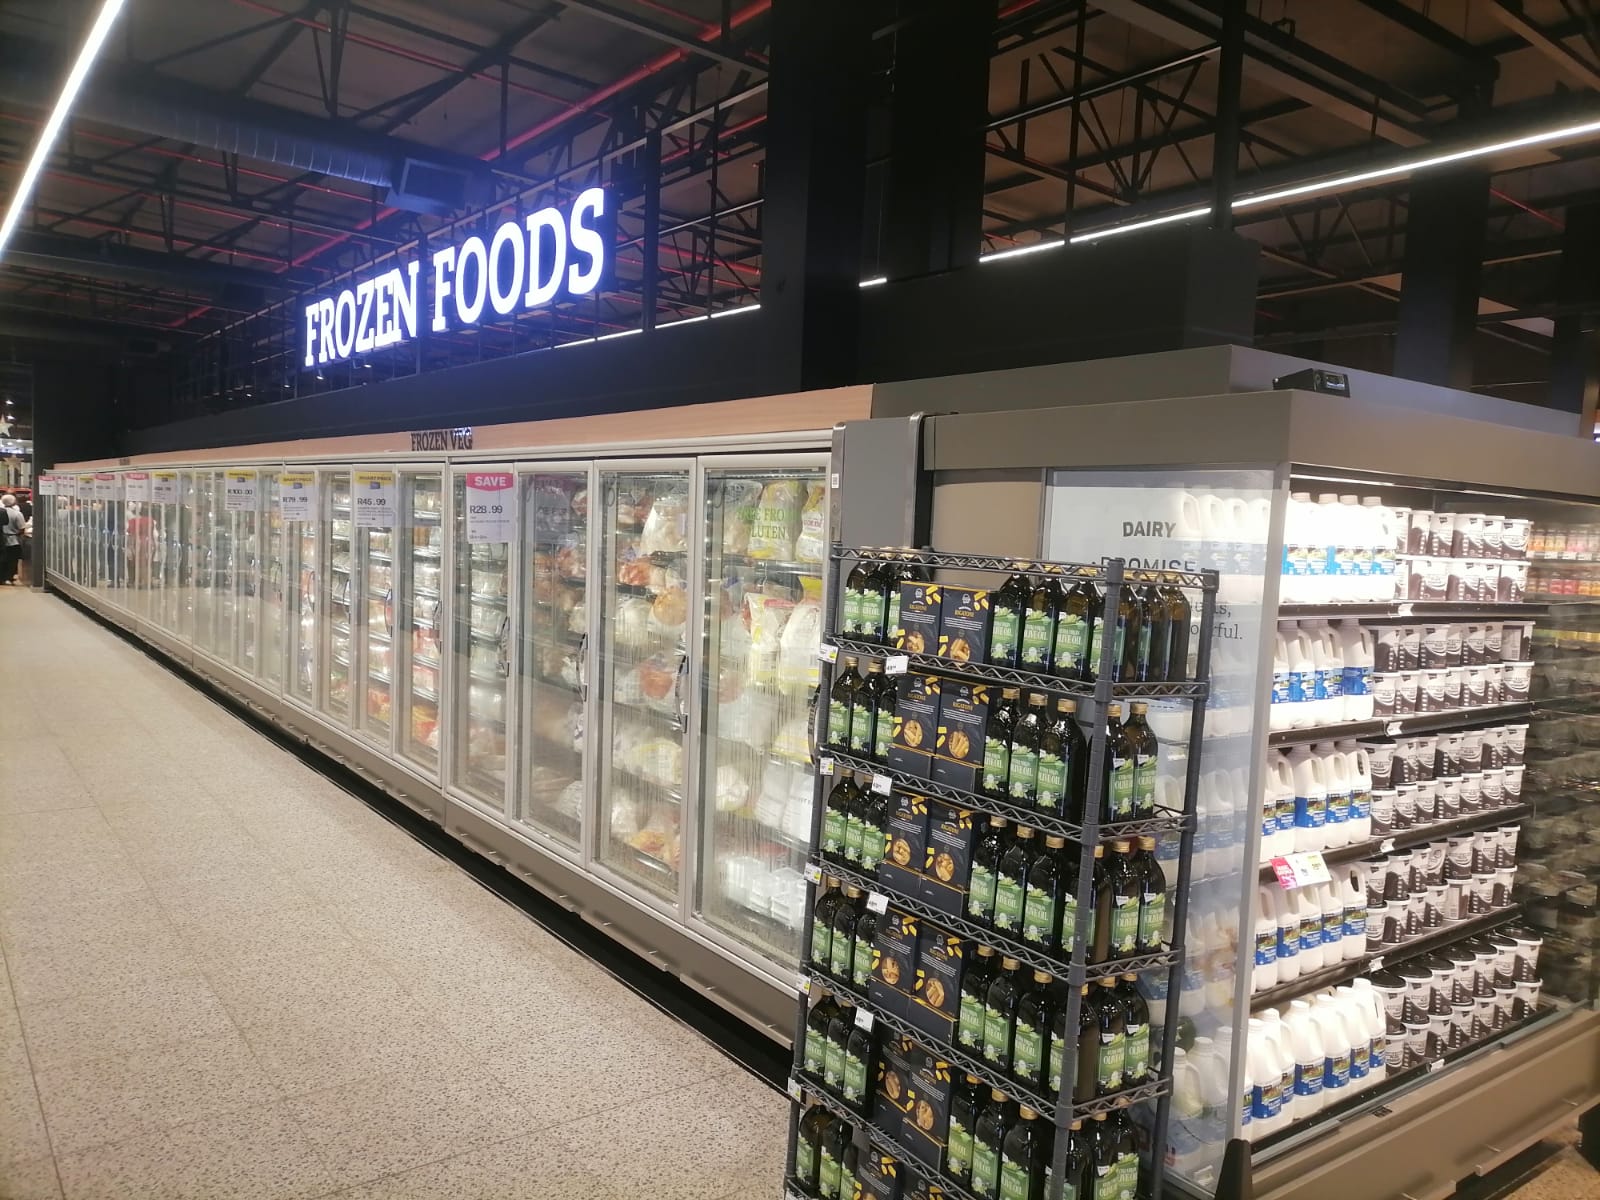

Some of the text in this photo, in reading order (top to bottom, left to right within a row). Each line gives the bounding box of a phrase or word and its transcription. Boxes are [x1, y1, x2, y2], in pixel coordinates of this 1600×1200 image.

[304, 187, 606, 367] FROZEN FOODS
[410, 429, 473, 451] FROZEN VEG
[474, 476, 507, 487] SAVE
[469, 505, 503, 514] R28.99
[1122, 521, 1177, 538] DAIRY
